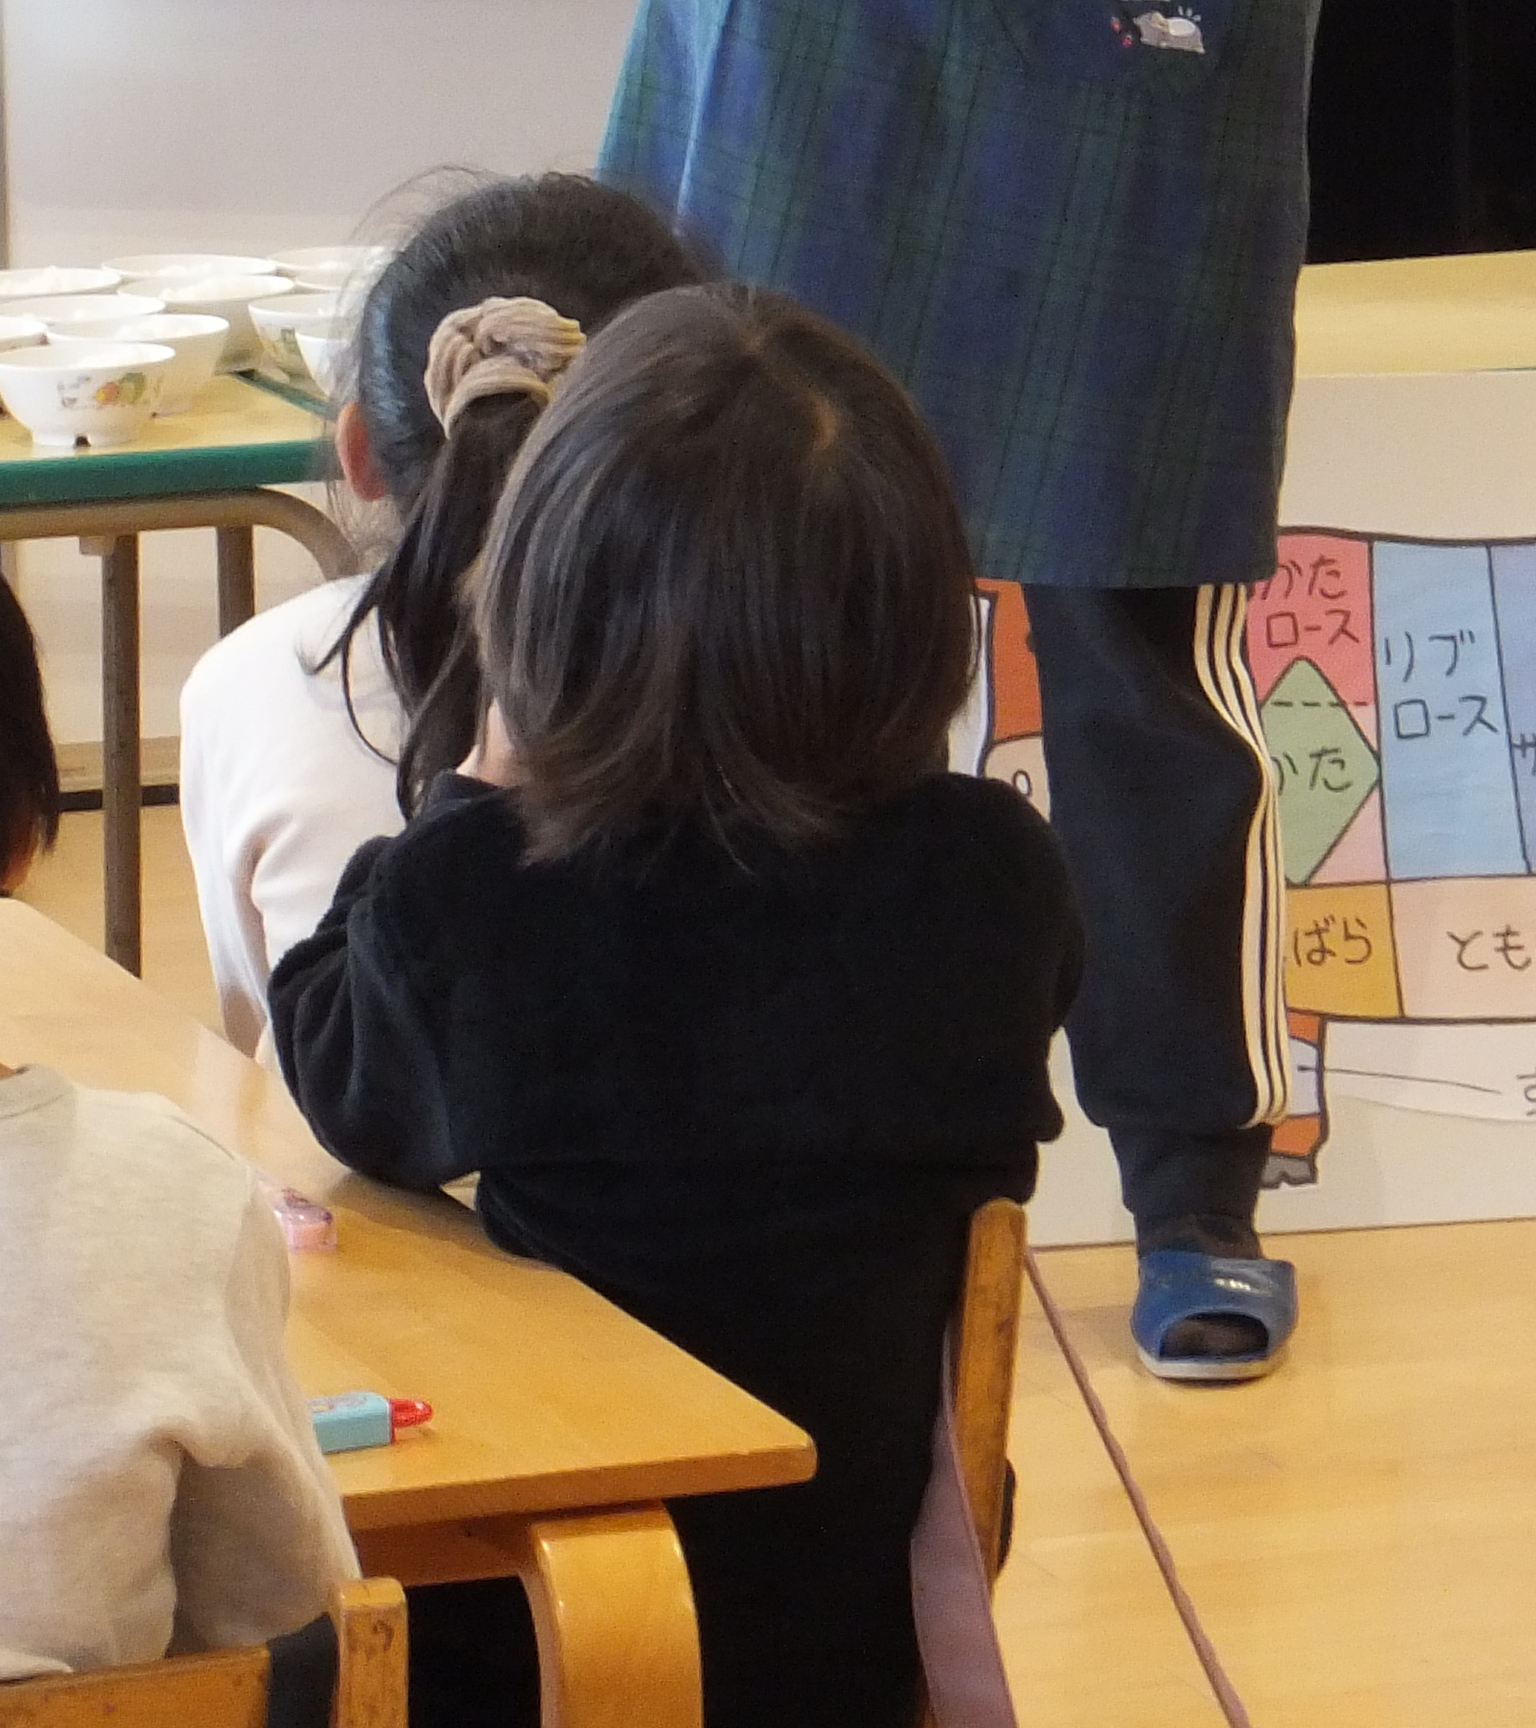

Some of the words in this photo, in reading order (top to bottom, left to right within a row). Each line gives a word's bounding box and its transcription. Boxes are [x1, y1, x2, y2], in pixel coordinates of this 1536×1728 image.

[1266, 608, 1360, 649] ロース
[1383, 628, 1476, 683] リブ
[1393, 694, 1499, 741] ロース
